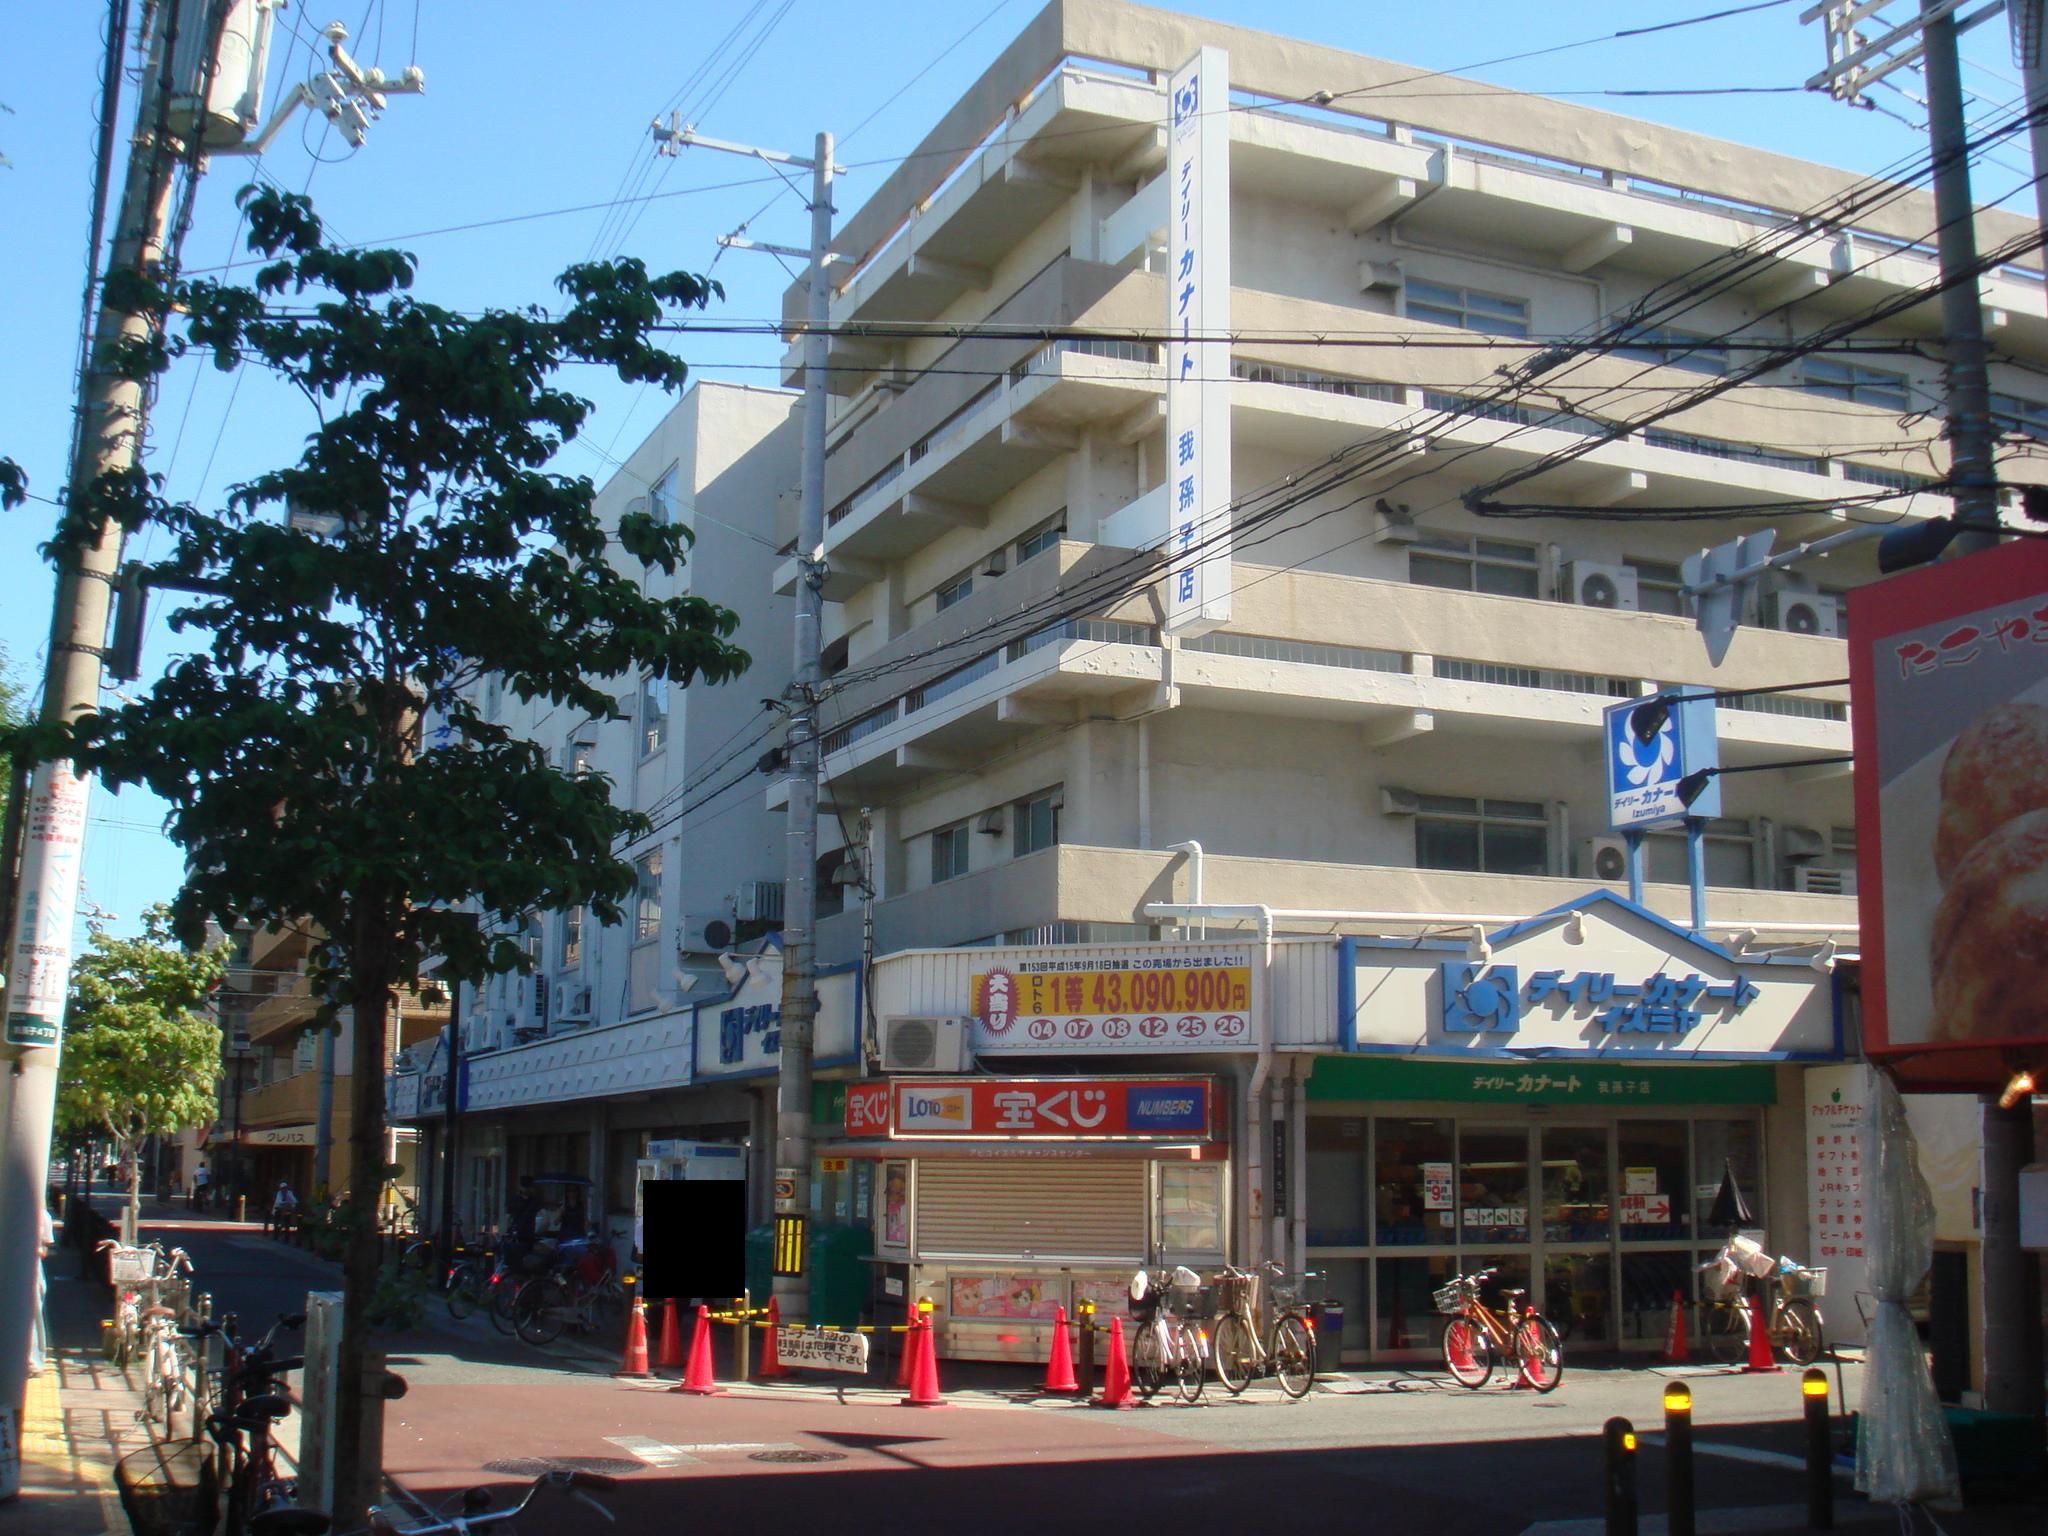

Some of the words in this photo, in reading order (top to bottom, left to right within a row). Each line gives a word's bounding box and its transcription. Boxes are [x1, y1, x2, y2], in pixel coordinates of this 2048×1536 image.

[1178, 156, 1196, 384] デイリーカナート
[1178, 430, 1195, 603] 我孫子店
[1614, 787, 1678, 809] デイリーカナー
[1632, 804, 1666, 819] Izumiya
[1031, 975, 1043, 1014] ロト6
[1050, 976, 1084, 1013] 1等
[1092, 970, 1246, 1013] 43,090,900円
[1528, 969, 1761, 1008] デイリーカナート
[1029, 1021, 1055, 1039] 04
[1066, 1020, 1091, 1038] 07
[1103, 1019, 1129, 1037] 08
[1141, 1018, 1166, 1036] 12
[1179, 1018, 1205, 1036] 25
[1217, 1017, 1242, 1035] 26
[1595, 1006, 1701, 1034] イズミヤ
[1472, 1073, 1582, 1094] デイリーカナート
[850, 1093, 887, 1127] 宝くじ
[908, 1096, 941, 1118] LOTO
[993, 1089, 1107, 1130] 宝くじ
[1137, 1099, 1194, 1116] NUMBERS
